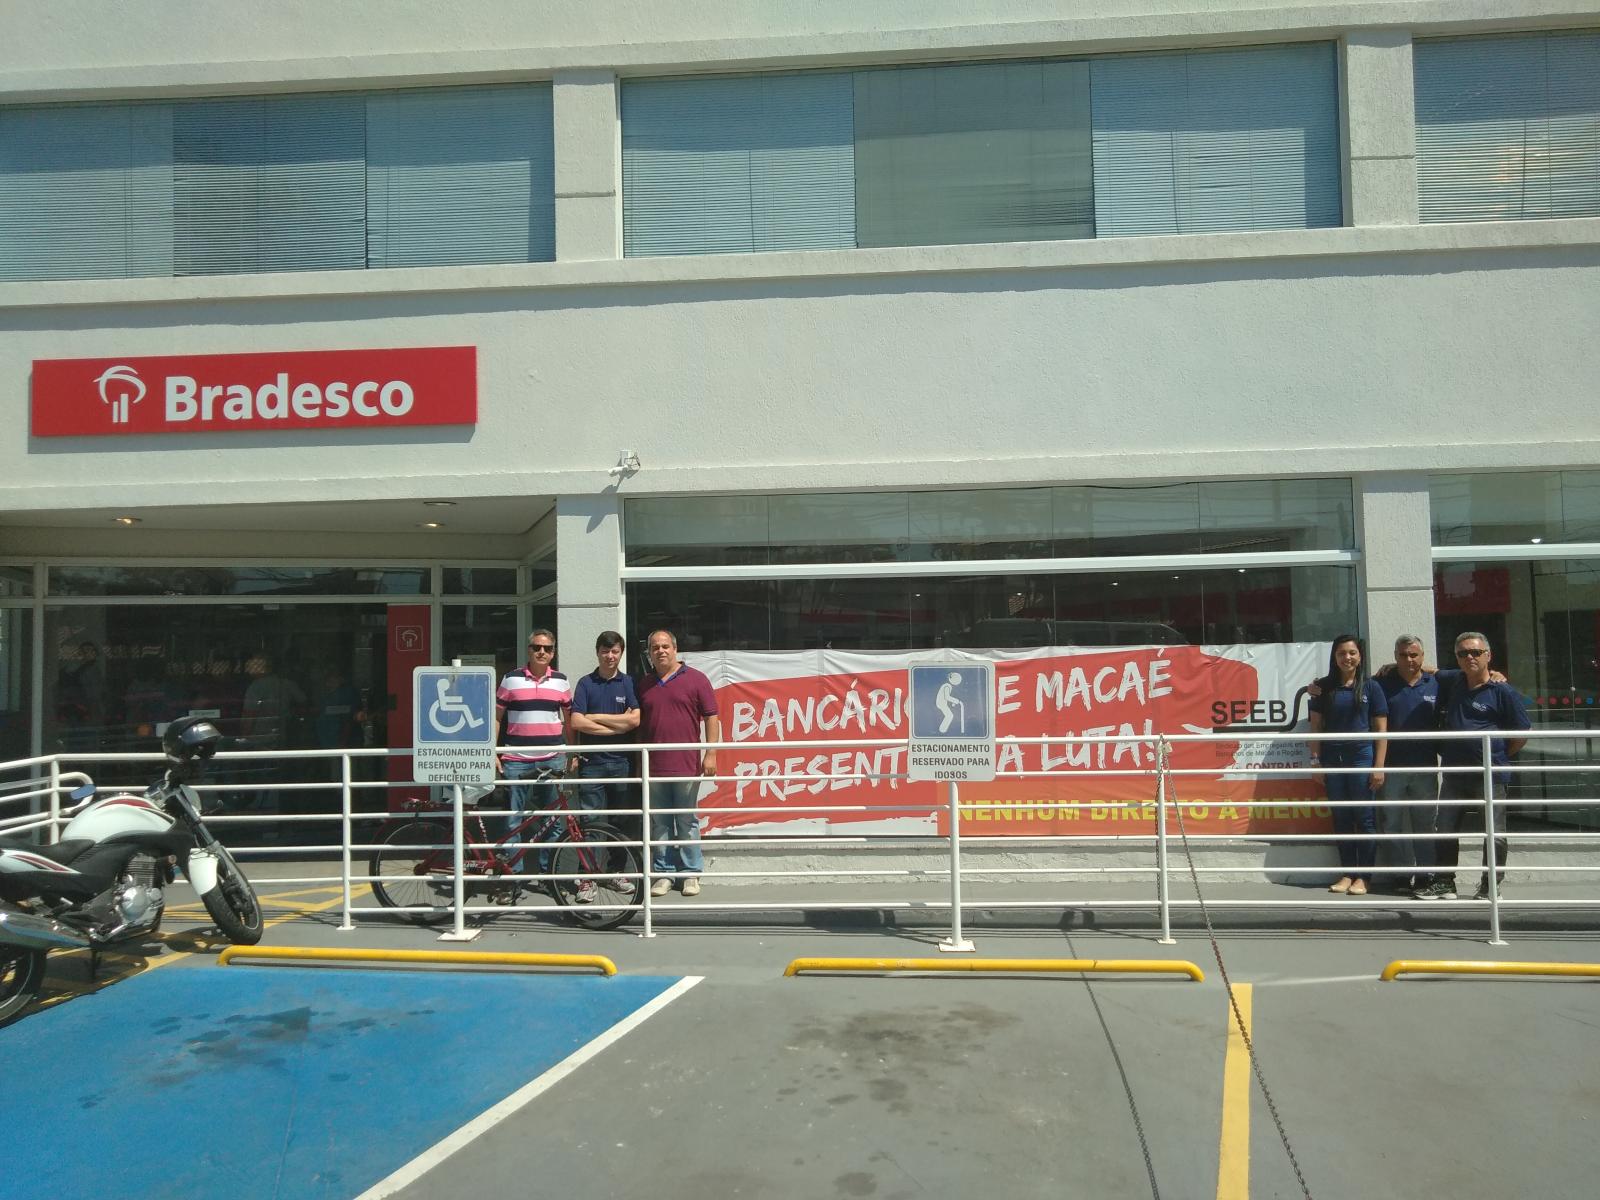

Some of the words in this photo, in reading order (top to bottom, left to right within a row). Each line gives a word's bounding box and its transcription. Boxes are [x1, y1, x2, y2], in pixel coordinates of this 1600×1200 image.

[165, 373, 414, 422] Bradesco
[731, 678, 909, 742] BANCÁRI
[1035, 647, 1174, 713] MACAÉ
[417, 748, 492, 757] ESTACIONAMENTO
[911, 744, 990, 753] ESTACIONAMENTO
[418, 761, 468, 770] RESERVADO
[469, 761, 491, 769] PARA
[733, 746, 917, 803] PRESENT
[1040, 719, 1158, 771] LUTA!
[912, 757, 964, 766] RESERVADO
[966, 757, 990, 766] PARA
[428, 774, 481, 782] DEFICIENTES
[934, 771, 968, 779] IDOSOS
[957, 799, 1080, 821] NENHUM
[1091, 798, 1209, 821] DIRETO
[1218, 798, 1240, 820] A
